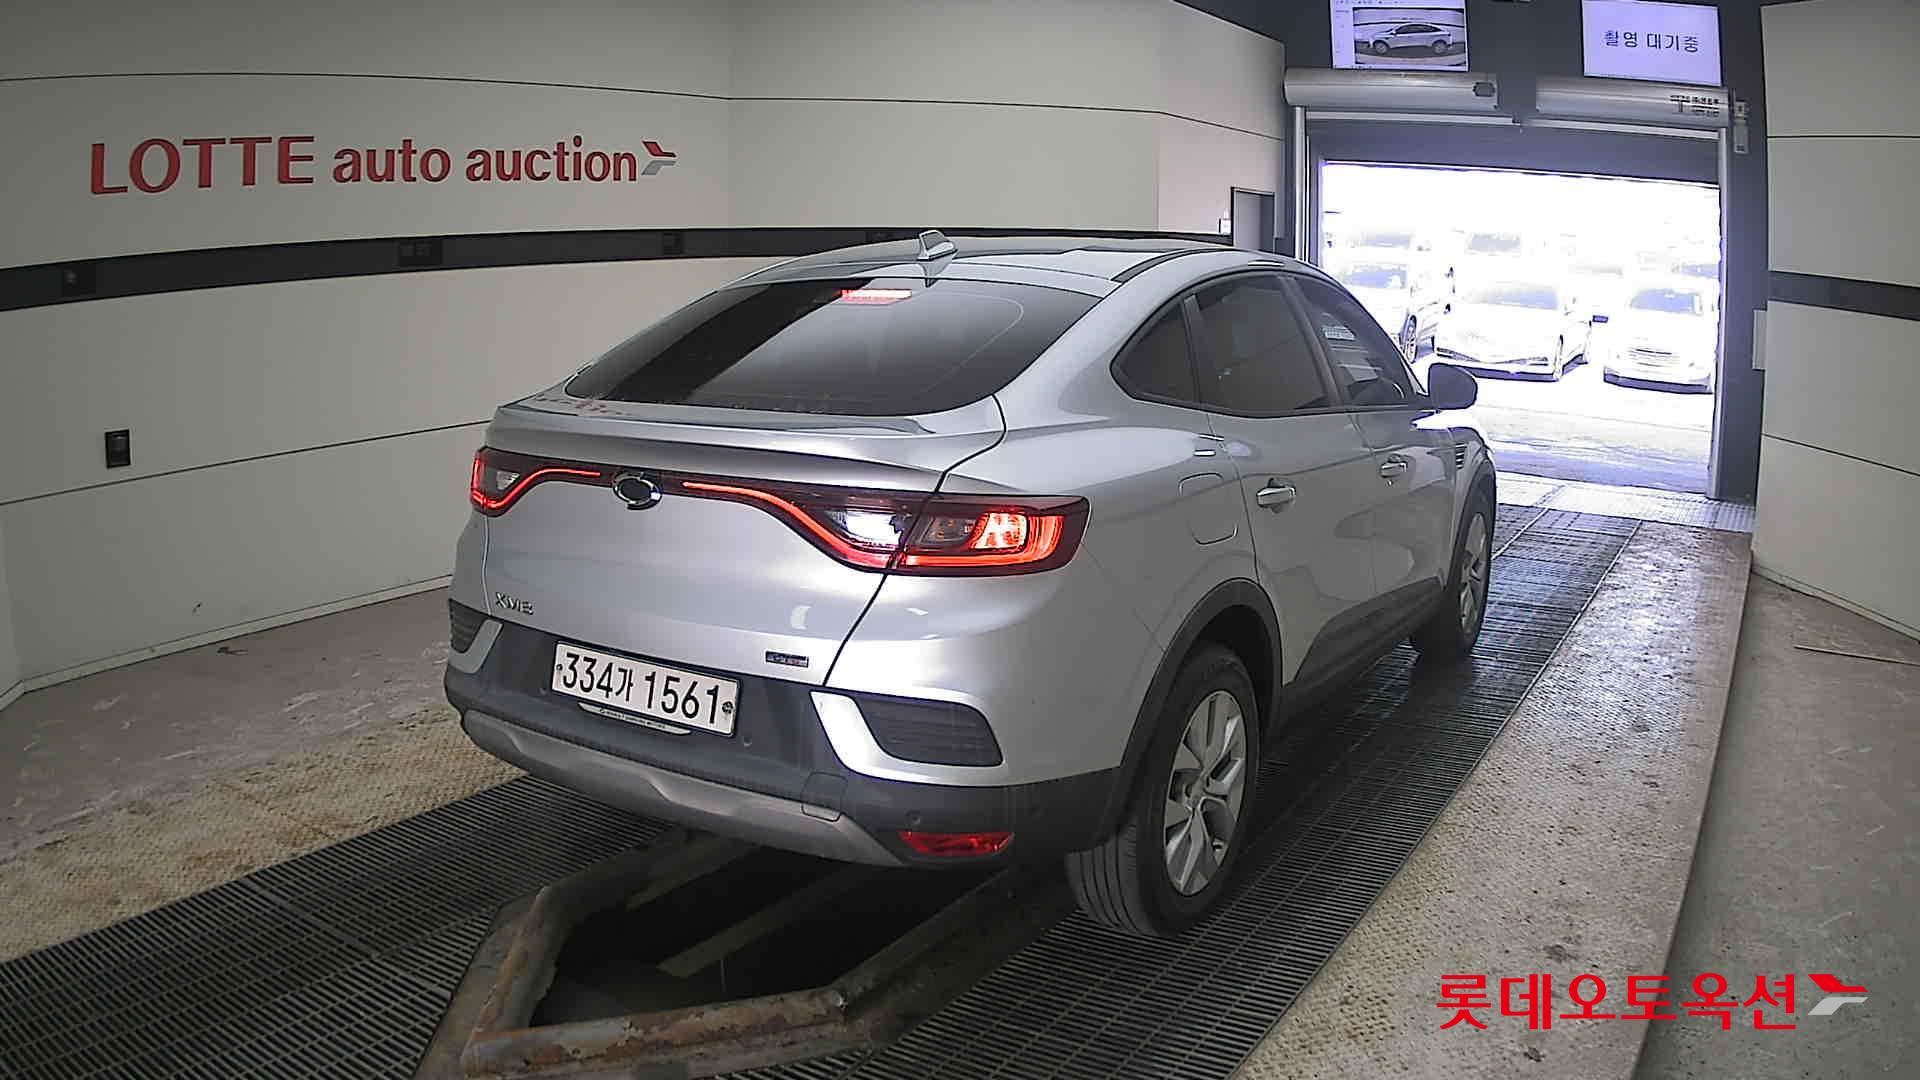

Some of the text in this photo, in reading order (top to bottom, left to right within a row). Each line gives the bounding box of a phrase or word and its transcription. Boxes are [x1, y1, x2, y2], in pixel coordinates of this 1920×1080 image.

[1646, 33, 1698, 53] 대기중
[90, 135, 638, 194] LOTTE auto auction
[561, 652, 720, 725] 334가 1561
